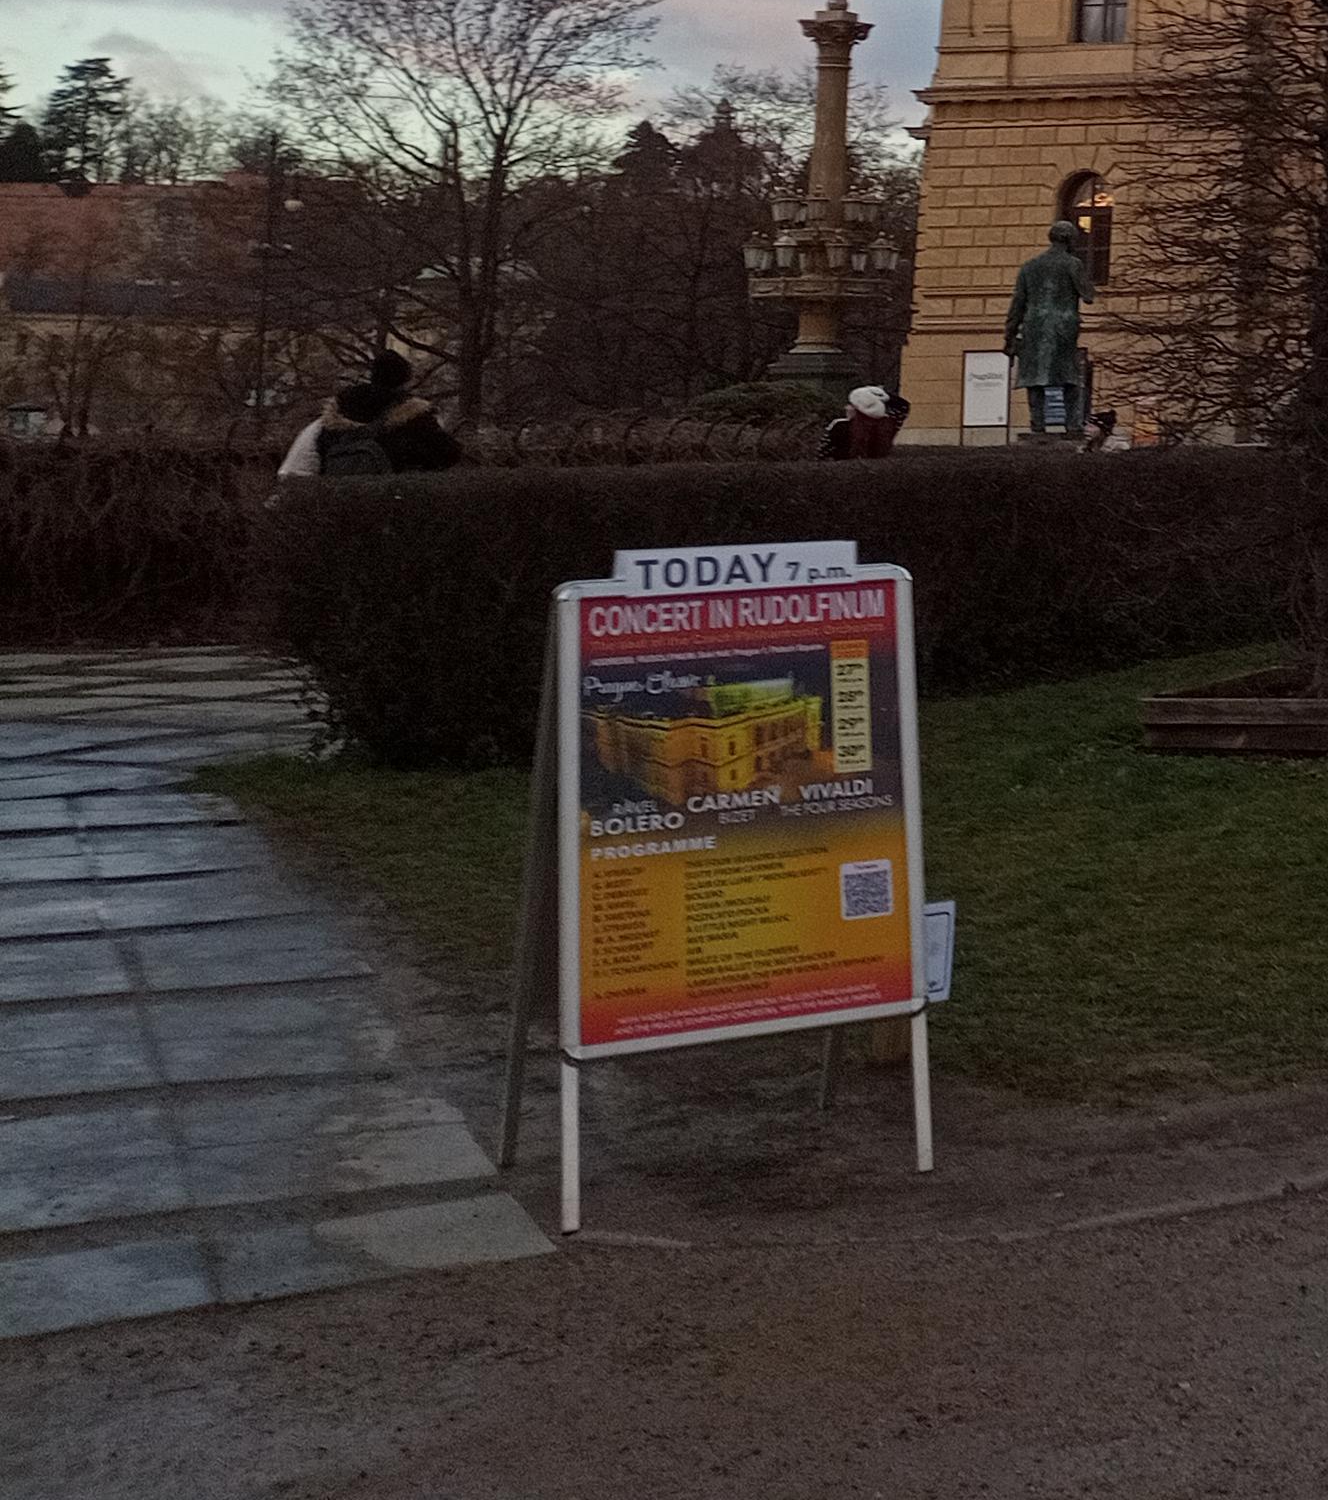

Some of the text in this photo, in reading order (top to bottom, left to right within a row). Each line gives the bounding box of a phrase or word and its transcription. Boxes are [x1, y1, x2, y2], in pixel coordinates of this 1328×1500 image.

[635, 552, 852, 590] TODAY 7 p.m.
[588, 589, 886, 637] CONCERT IN RUDOLFINUM
[687, 784, 782, 813] CARMEN
[798, 777, 874, 801] VIVALDI
[590, 811, 685, 837] BOLERO
[590, 835, 717, 860] PROGRAMME
